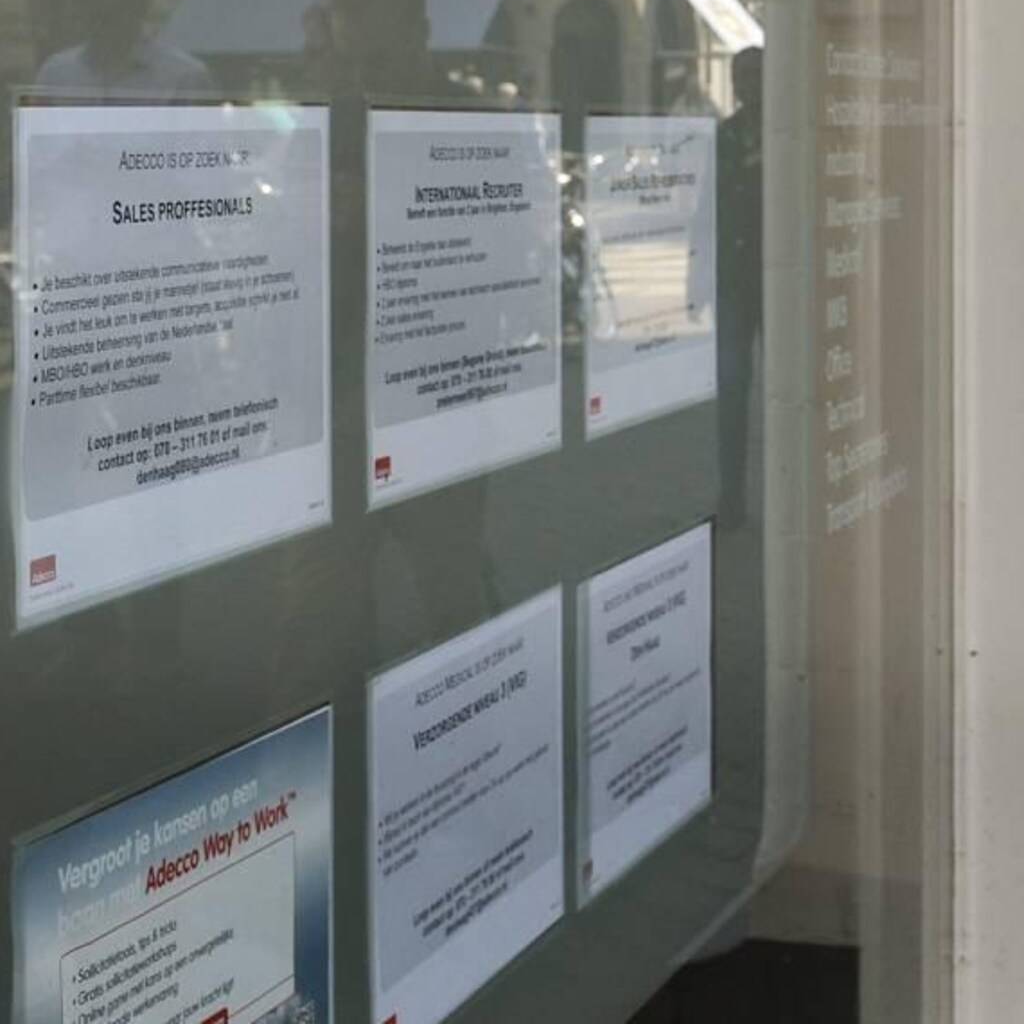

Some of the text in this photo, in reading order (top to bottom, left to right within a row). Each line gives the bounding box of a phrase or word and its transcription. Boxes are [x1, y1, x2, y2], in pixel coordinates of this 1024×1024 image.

[118, 150, 165, 170] ADECCO
[167, 153, 176, 169] IS
[179, 152, 193, 169] OP
[195, 151, 221, 168] ZOEK
[112, 197, 253, 224] SALES PROFFESIONALS
[41, 361, 88, 383] MBO/HBO
[87, 435, 114, 452] Loop
[115, 429, 138, 445] even
[141, 422, 153, 441] bij
[154, 421, 171, 437] ons
[98, 451, 134, 472] contact
[58, 779, 258, 893] Vergroot je kansen op een
[145, 847, 199, 895] Adecco
[203, 828, 233, 863] Way
[236, 820, 251, 845] to
